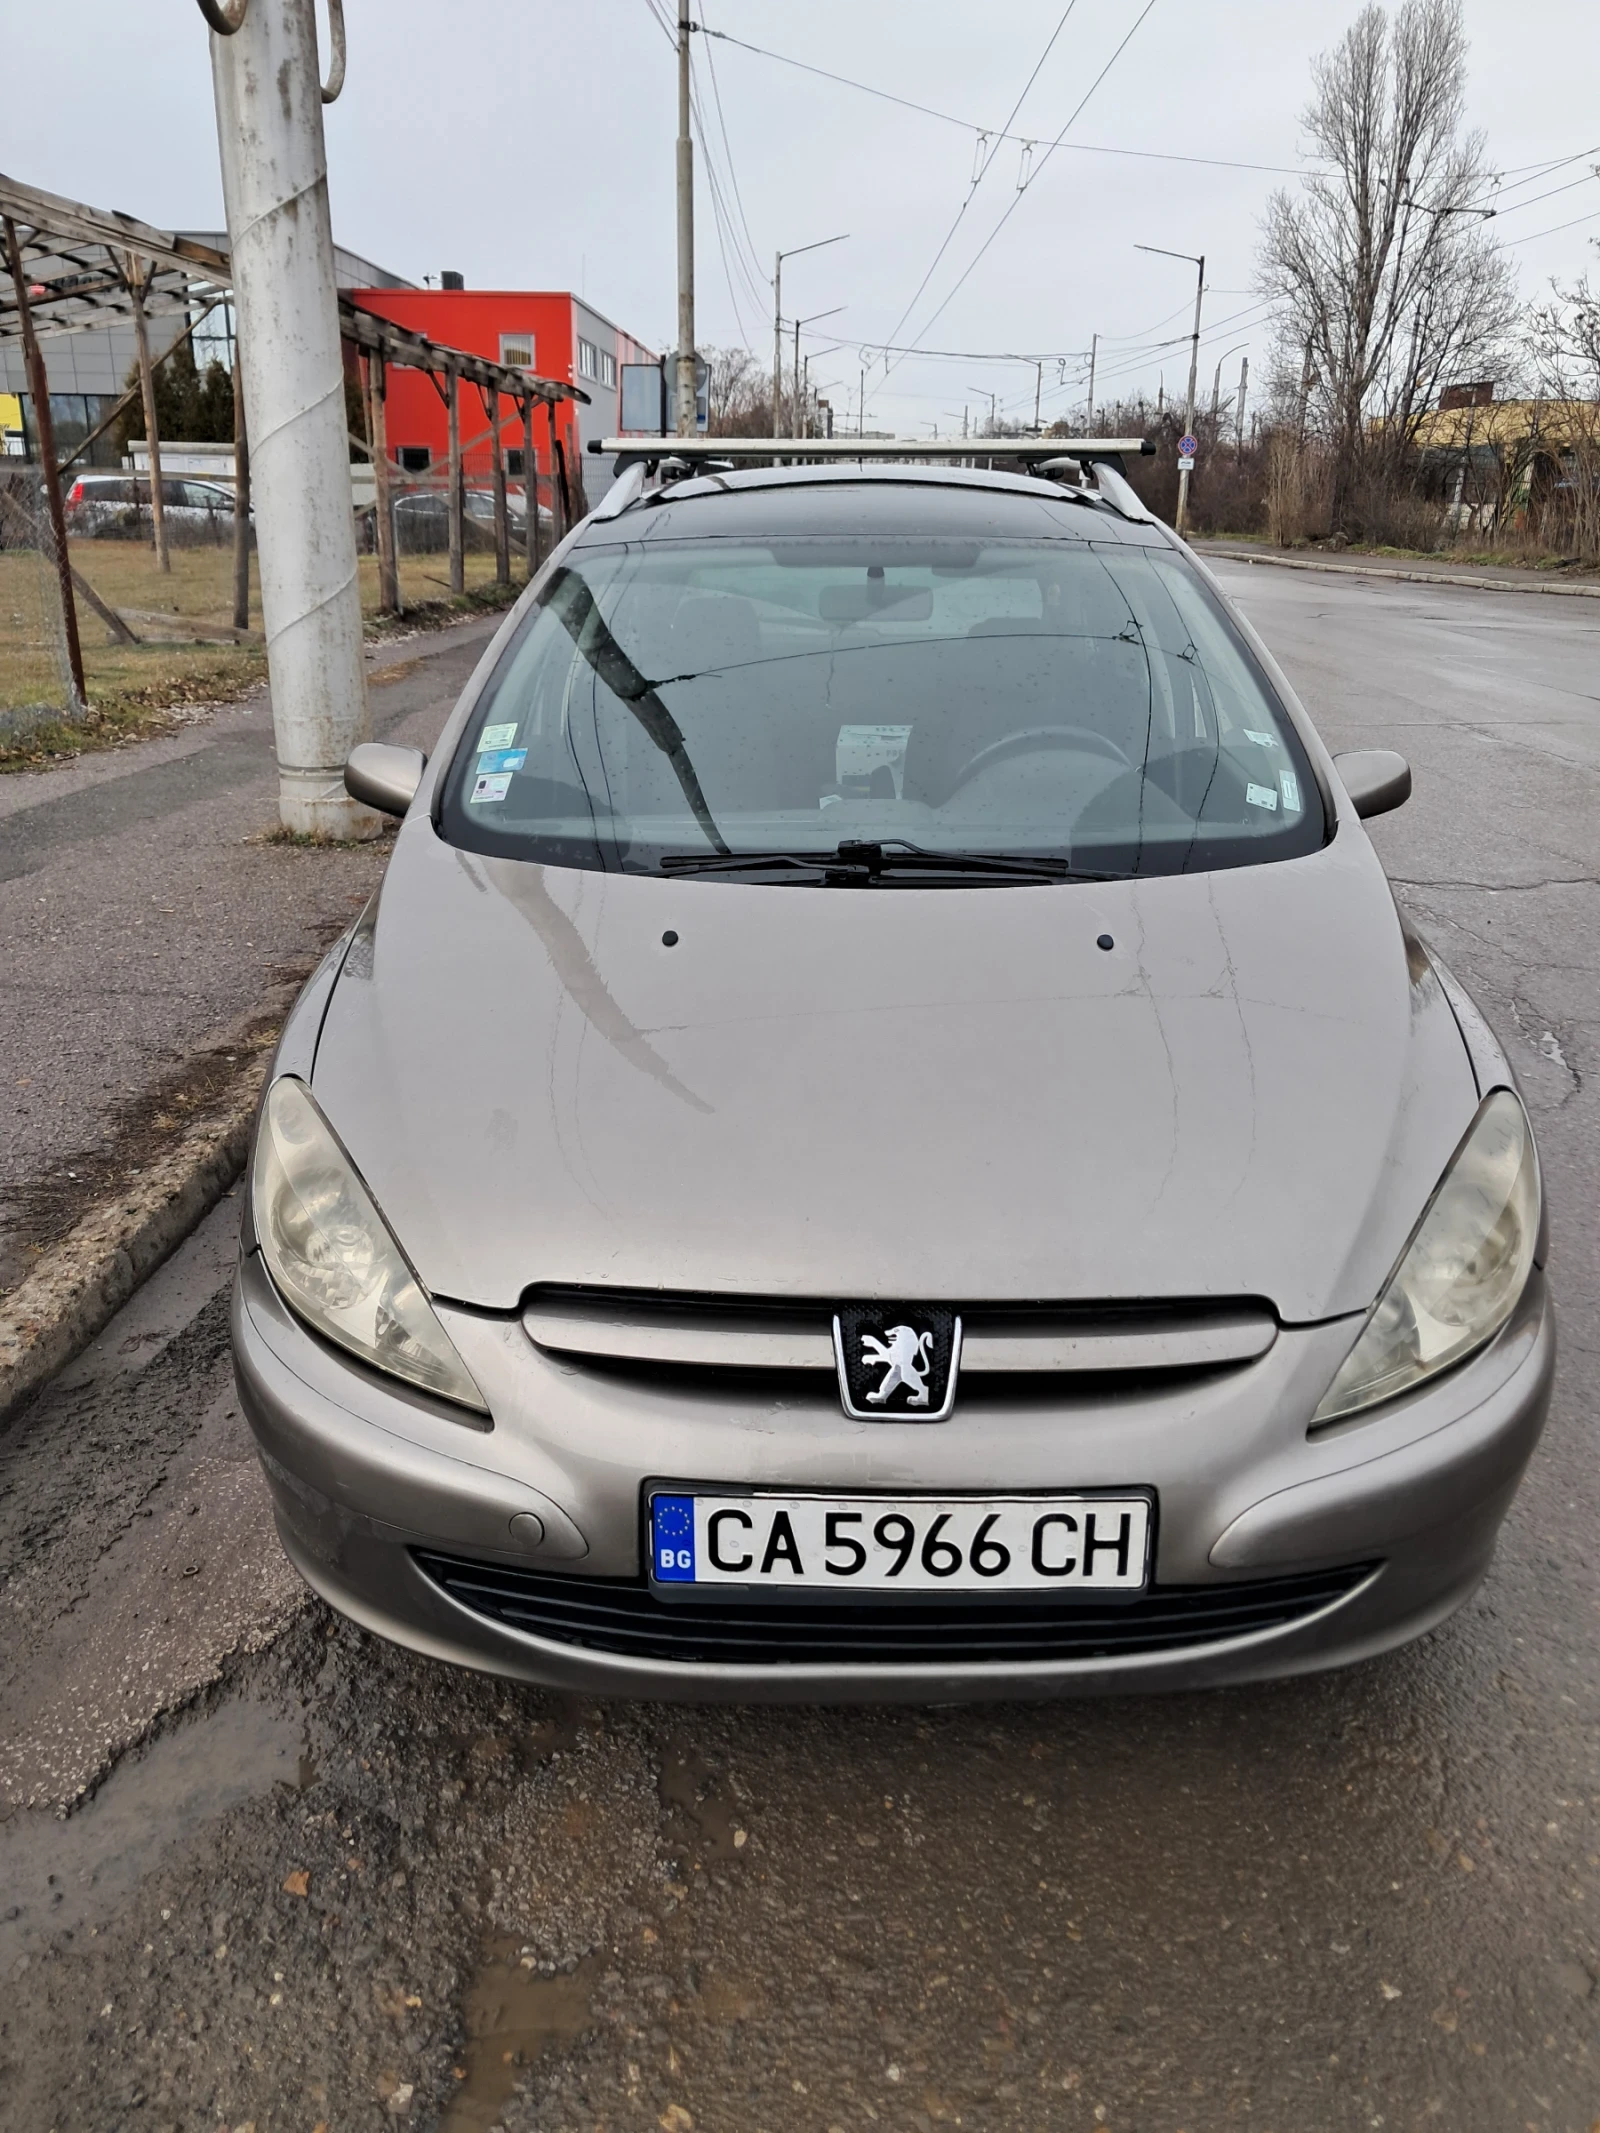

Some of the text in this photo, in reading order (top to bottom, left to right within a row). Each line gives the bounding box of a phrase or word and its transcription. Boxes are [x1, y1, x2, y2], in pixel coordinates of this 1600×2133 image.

[660, 1549, 692, 1570] BG
[707, 1509, 1131, 1577] CA 5966 CH
